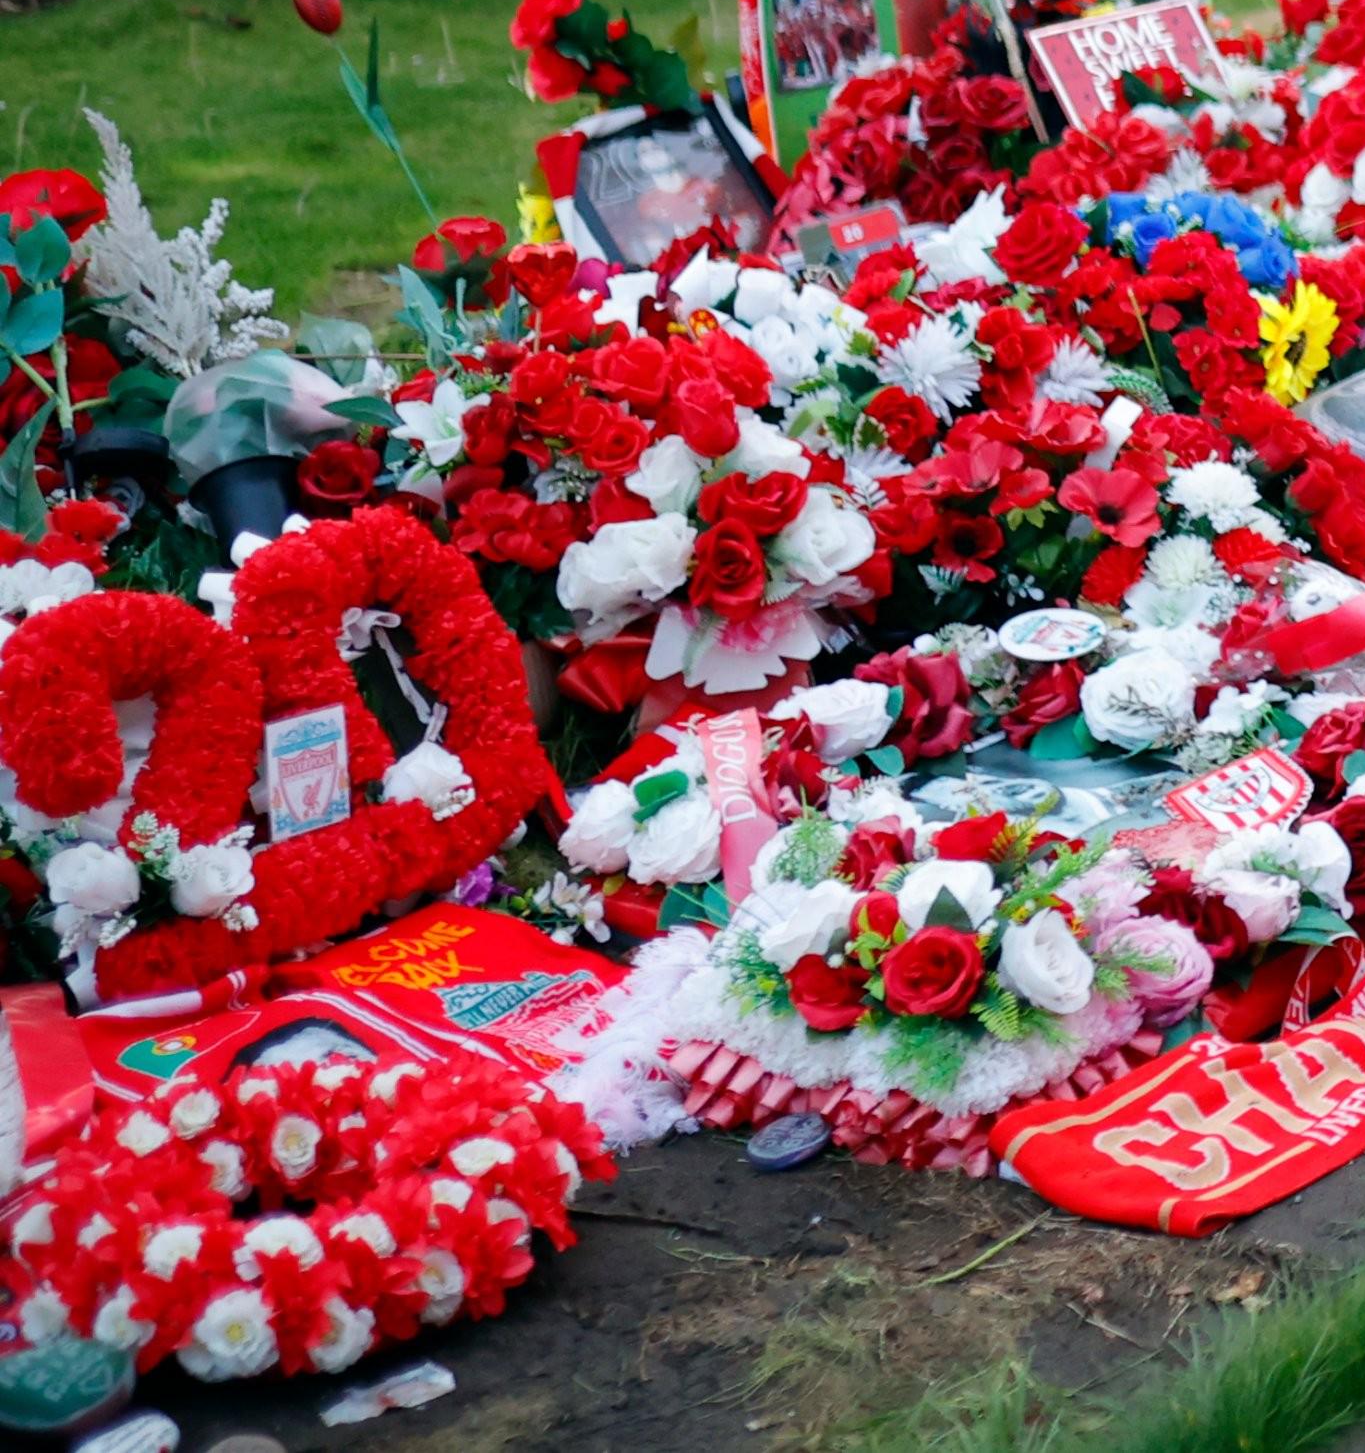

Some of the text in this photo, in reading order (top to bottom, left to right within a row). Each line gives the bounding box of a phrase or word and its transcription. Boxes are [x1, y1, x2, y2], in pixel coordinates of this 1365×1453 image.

[1068, 12, 1173, 62] HOME
[1084, 40, 1180, 89] SWEET
[709, 728, 757, 823] DIOGO
